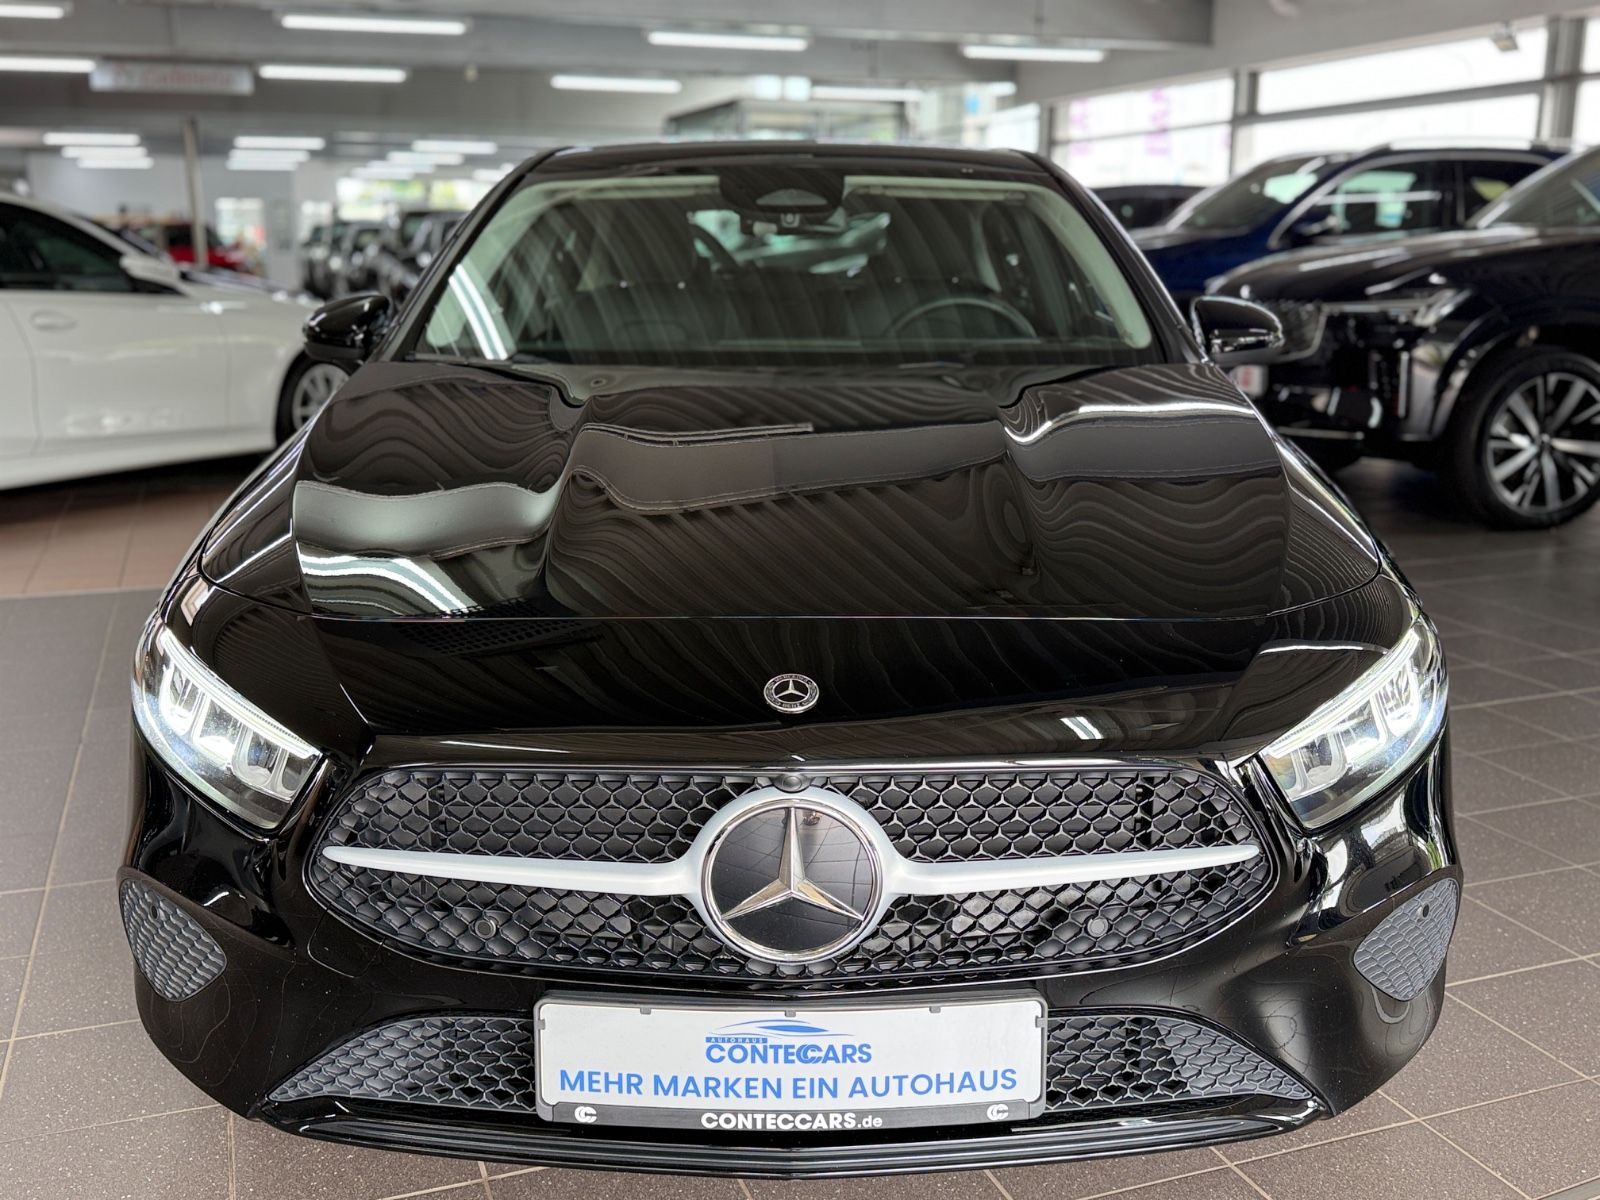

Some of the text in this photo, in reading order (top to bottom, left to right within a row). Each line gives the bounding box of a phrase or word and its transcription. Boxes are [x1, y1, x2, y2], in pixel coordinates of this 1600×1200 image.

[709, 1036, 765, 1044] AUTOHAUS
[559, 1068, 1018, 1099] MEHR MARKEN EIN AUTOHAUS
[700, 1112, 884, 1131] CONTECCARS.de
